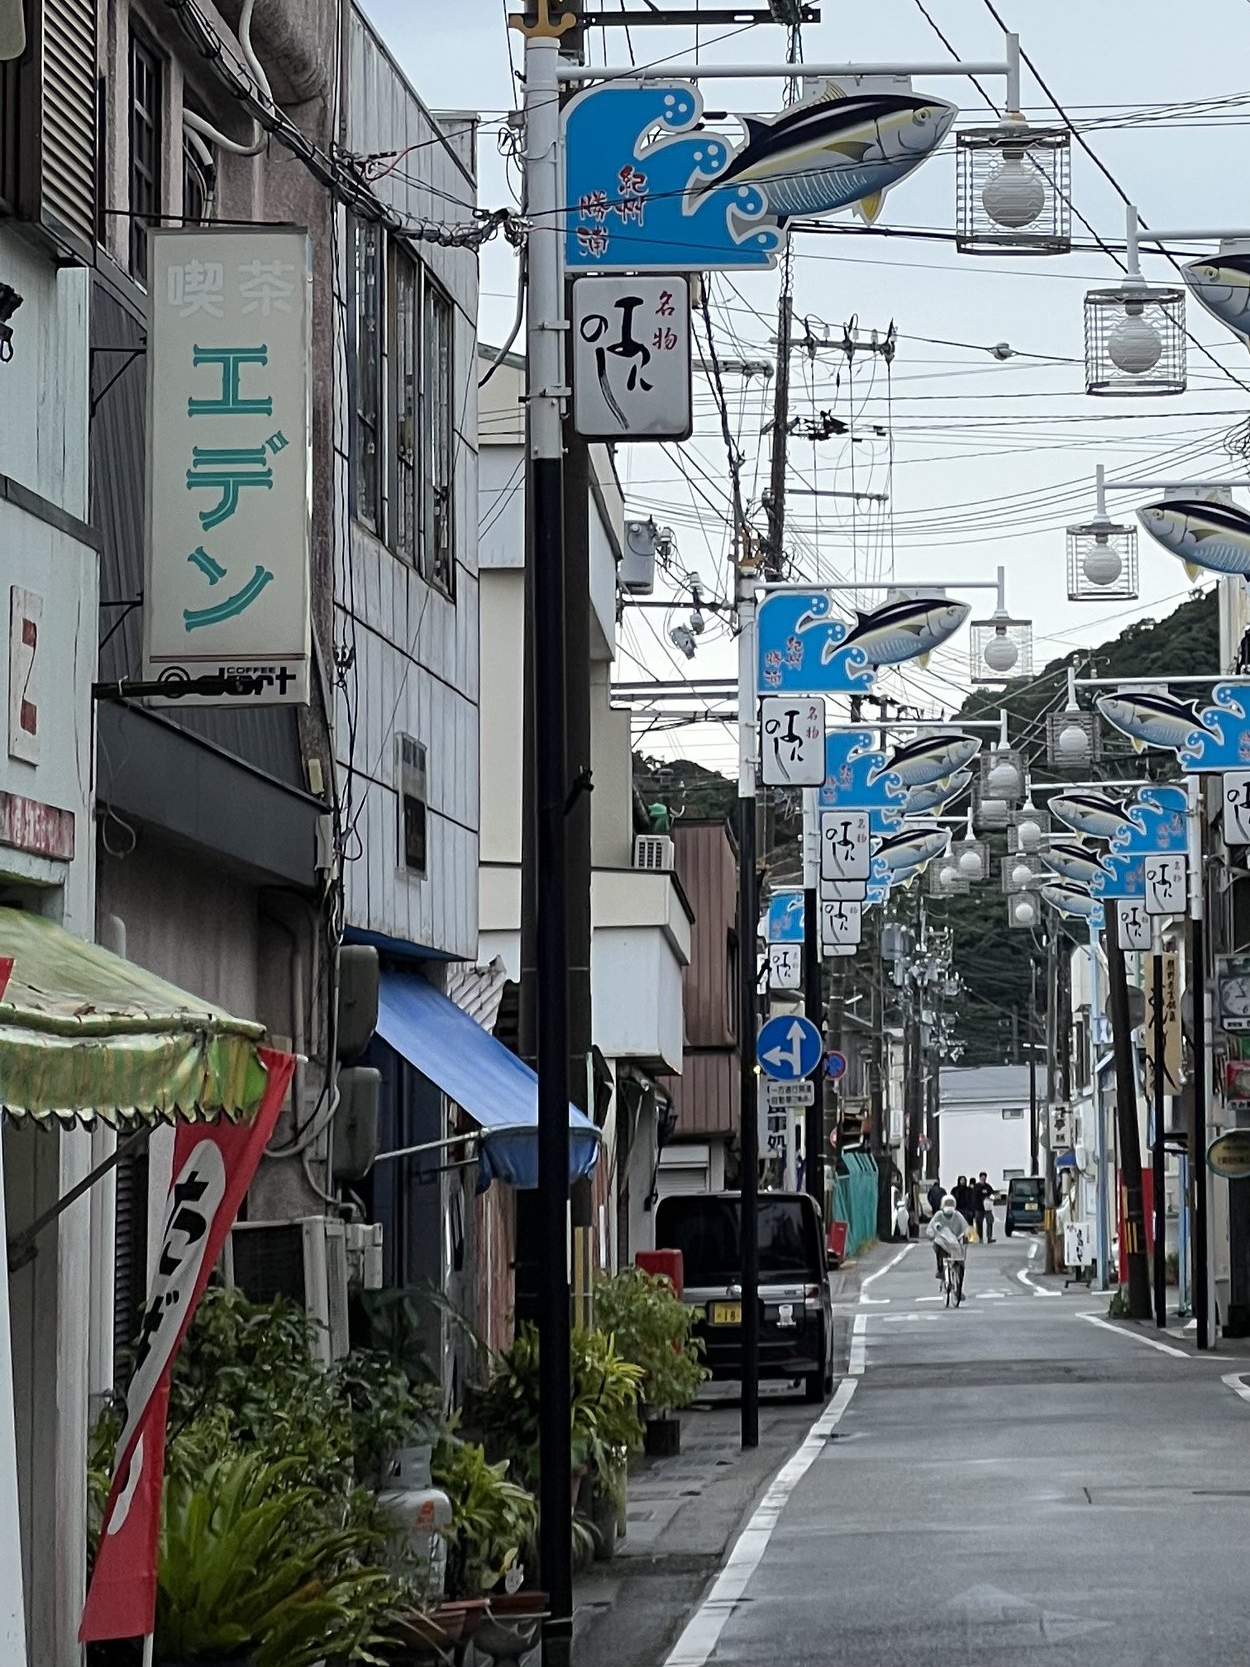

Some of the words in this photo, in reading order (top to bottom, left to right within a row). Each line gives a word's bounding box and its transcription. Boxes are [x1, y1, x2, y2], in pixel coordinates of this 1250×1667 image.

[576, 191, 611, 258] 勝浦
[615, 165, 648, 226] 紀州
[167, 260, 295, 319] 喫茶
[652, 290, 678, 351] 名物
[183, 343, 287, 633] エデン
